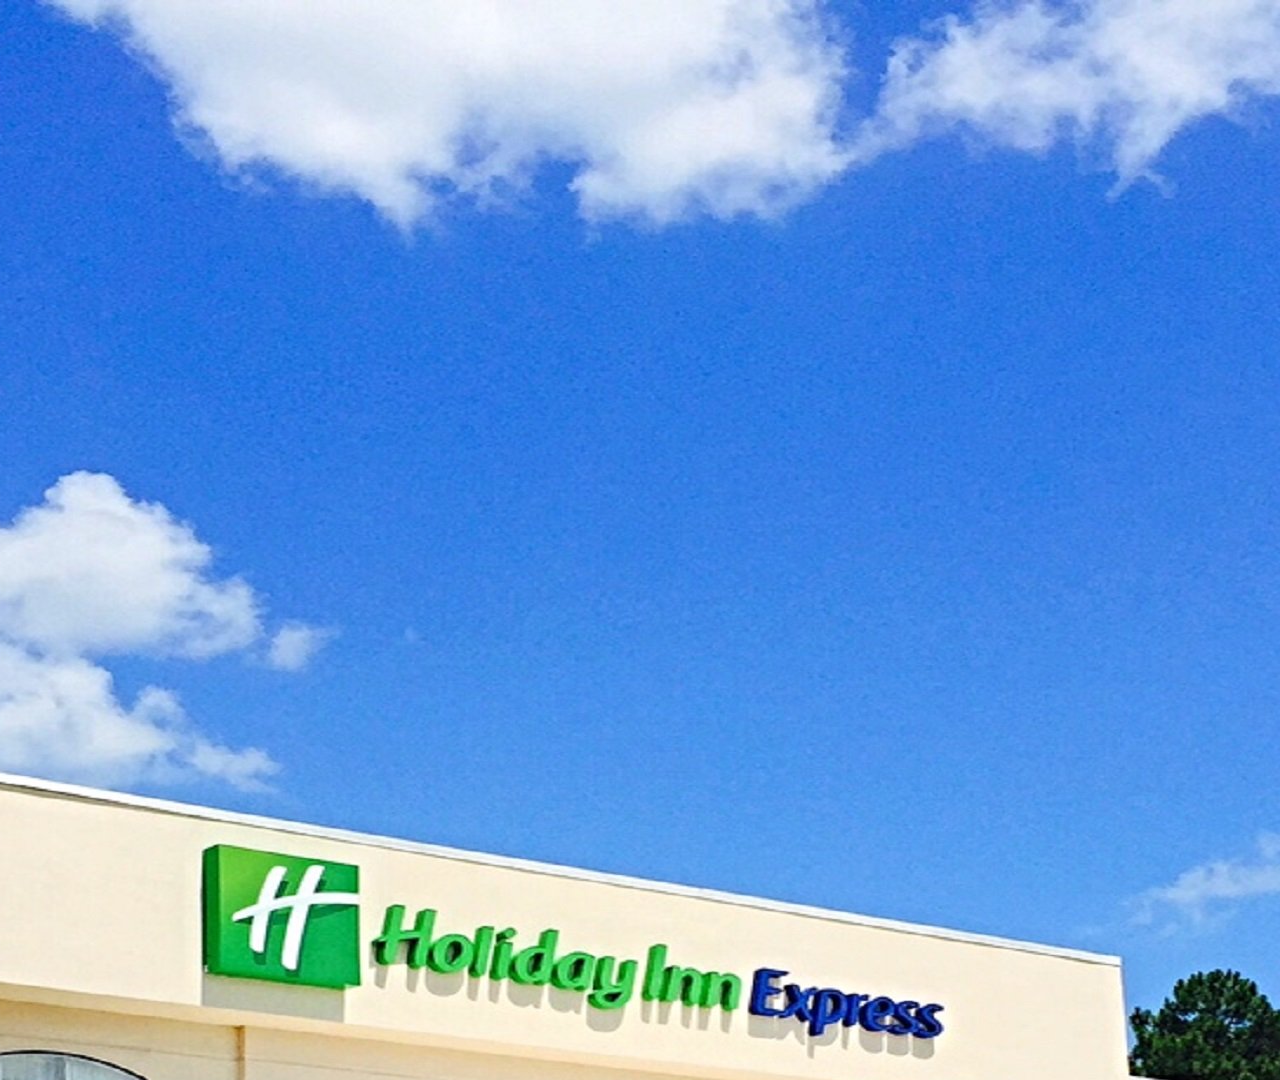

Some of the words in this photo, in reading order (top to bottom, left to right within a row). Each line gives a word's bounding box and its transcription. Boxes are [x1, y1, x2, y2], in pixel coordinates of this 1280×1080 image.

[371, 904, 638, 1010] Holiday
[641, 943, 742, 1012] Inn
[748, 967, 945, 1038] Express
